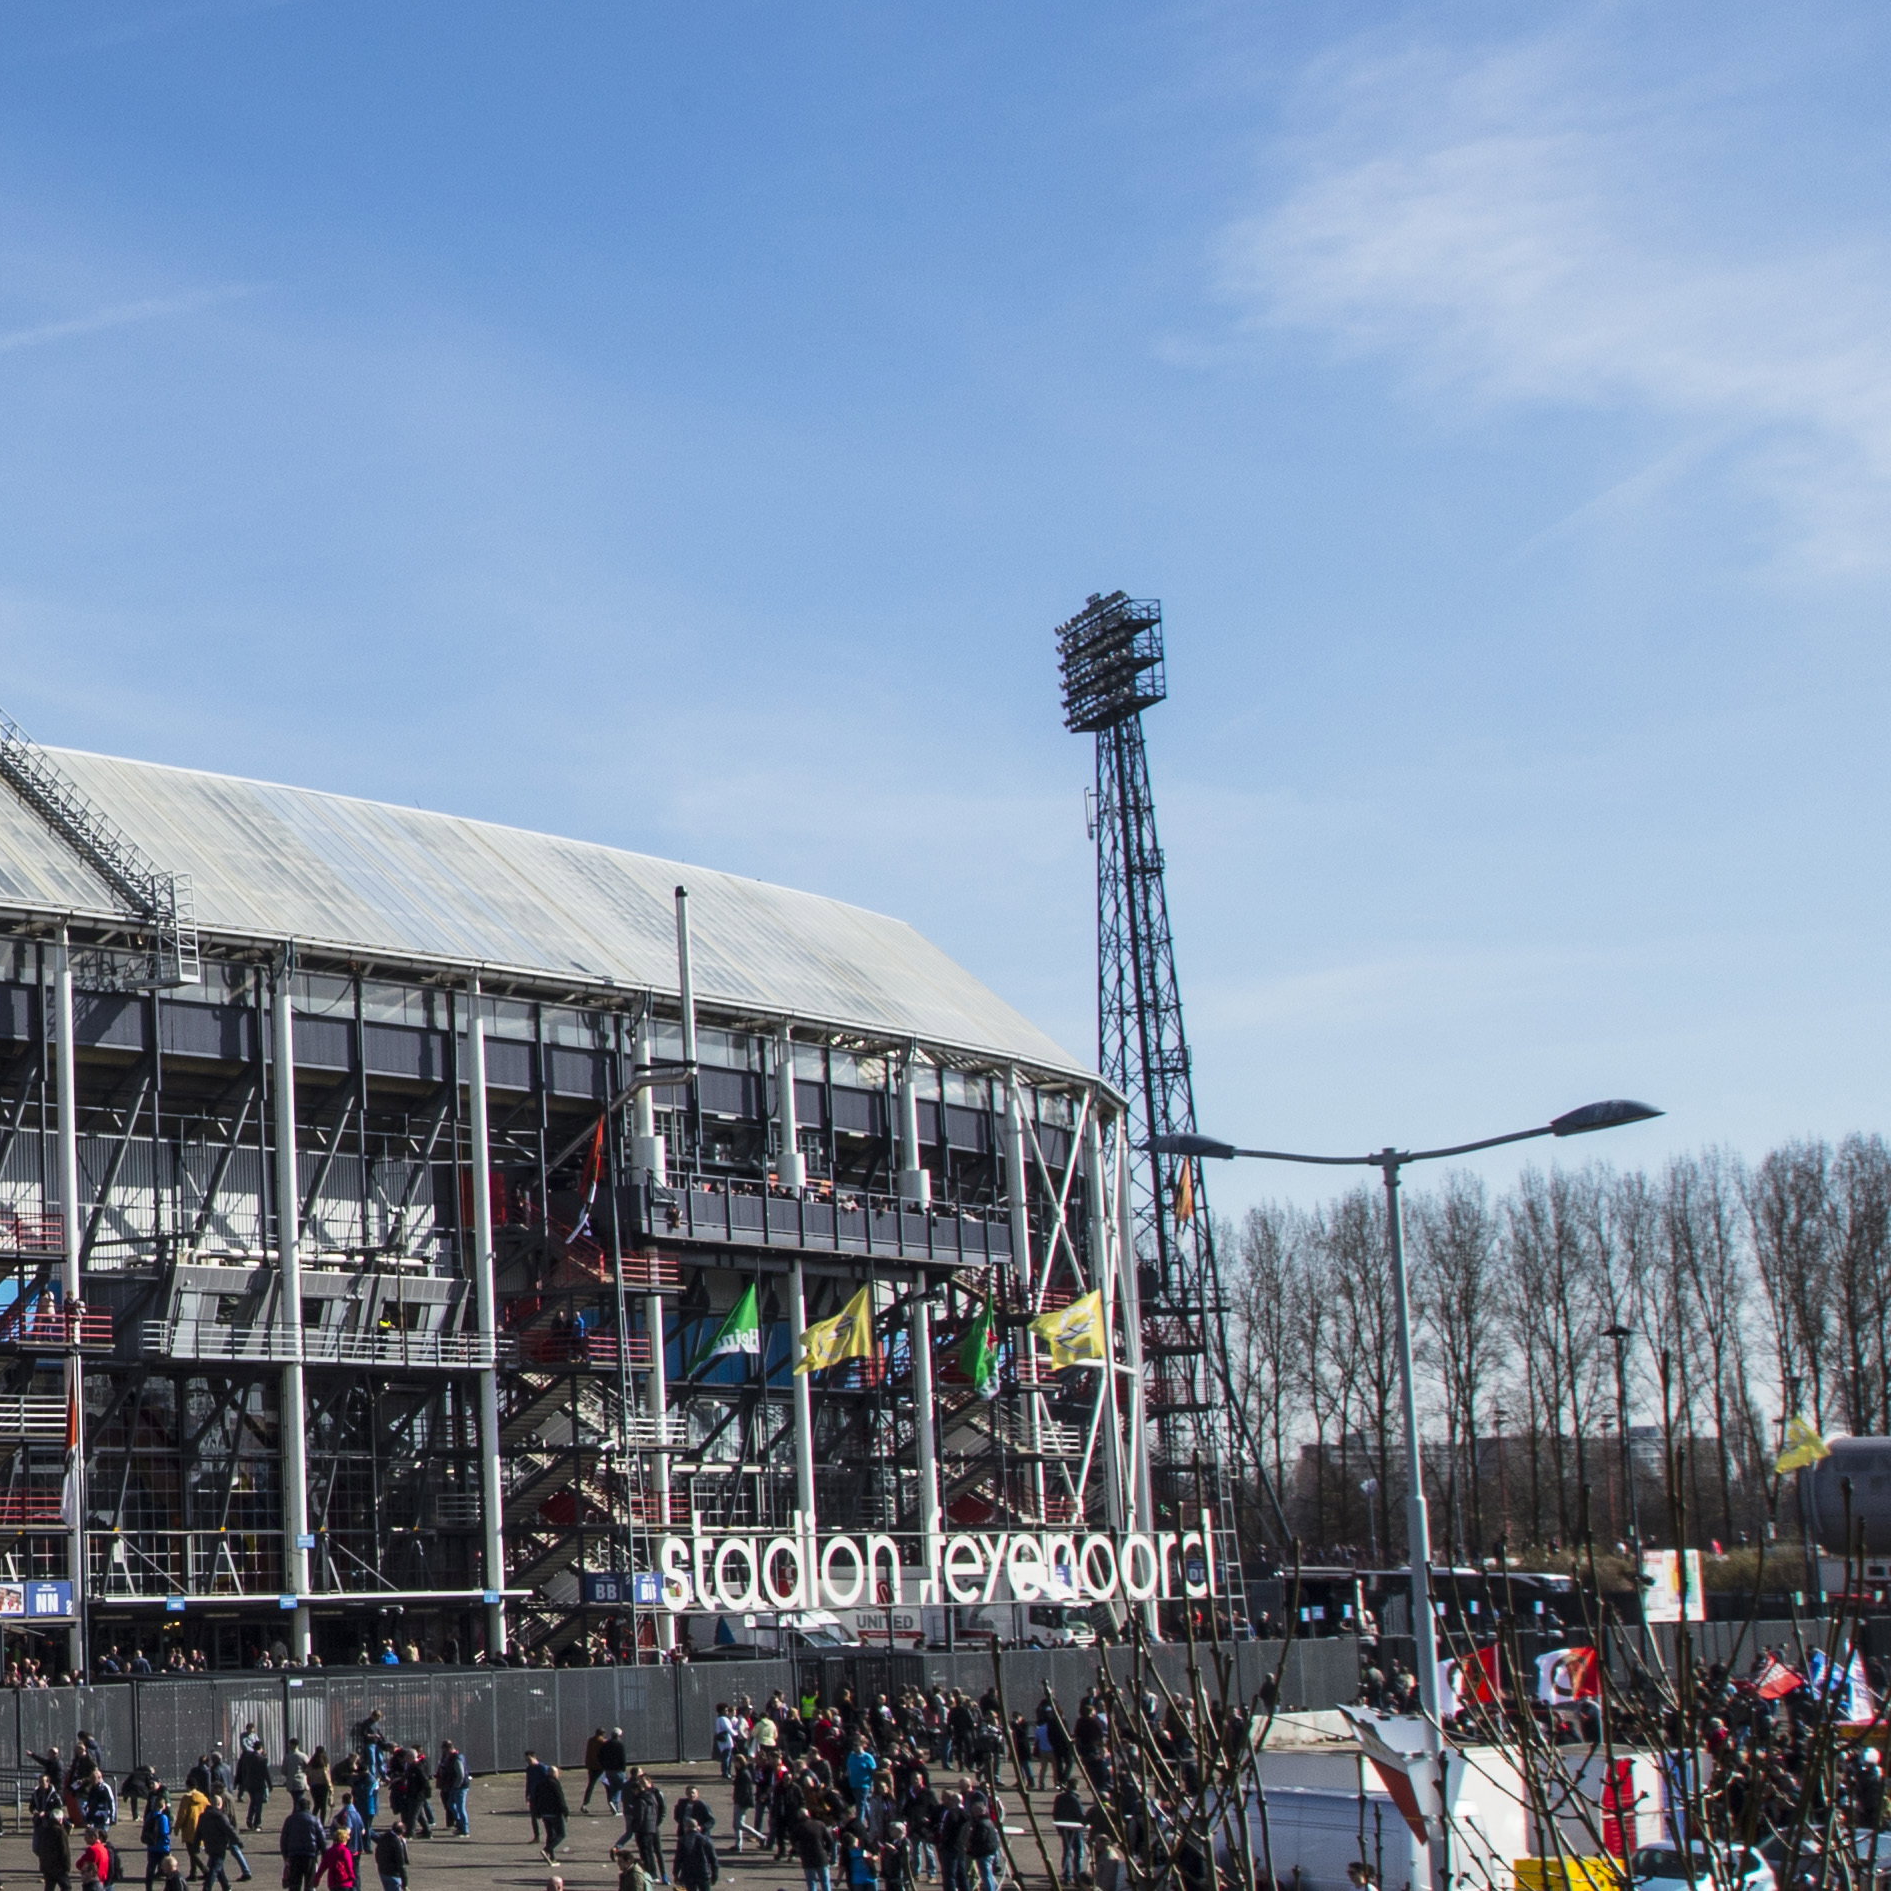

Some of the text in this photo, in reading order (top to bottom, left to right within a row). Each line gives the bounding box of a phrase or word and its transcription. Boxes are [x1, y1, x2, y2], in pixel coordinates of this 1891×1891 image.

[661, 1507, 1216, 1611] stadion feyenoord
[595, 1583, 617, 1600] BB
[35, 1593, 59, 1613] NN
